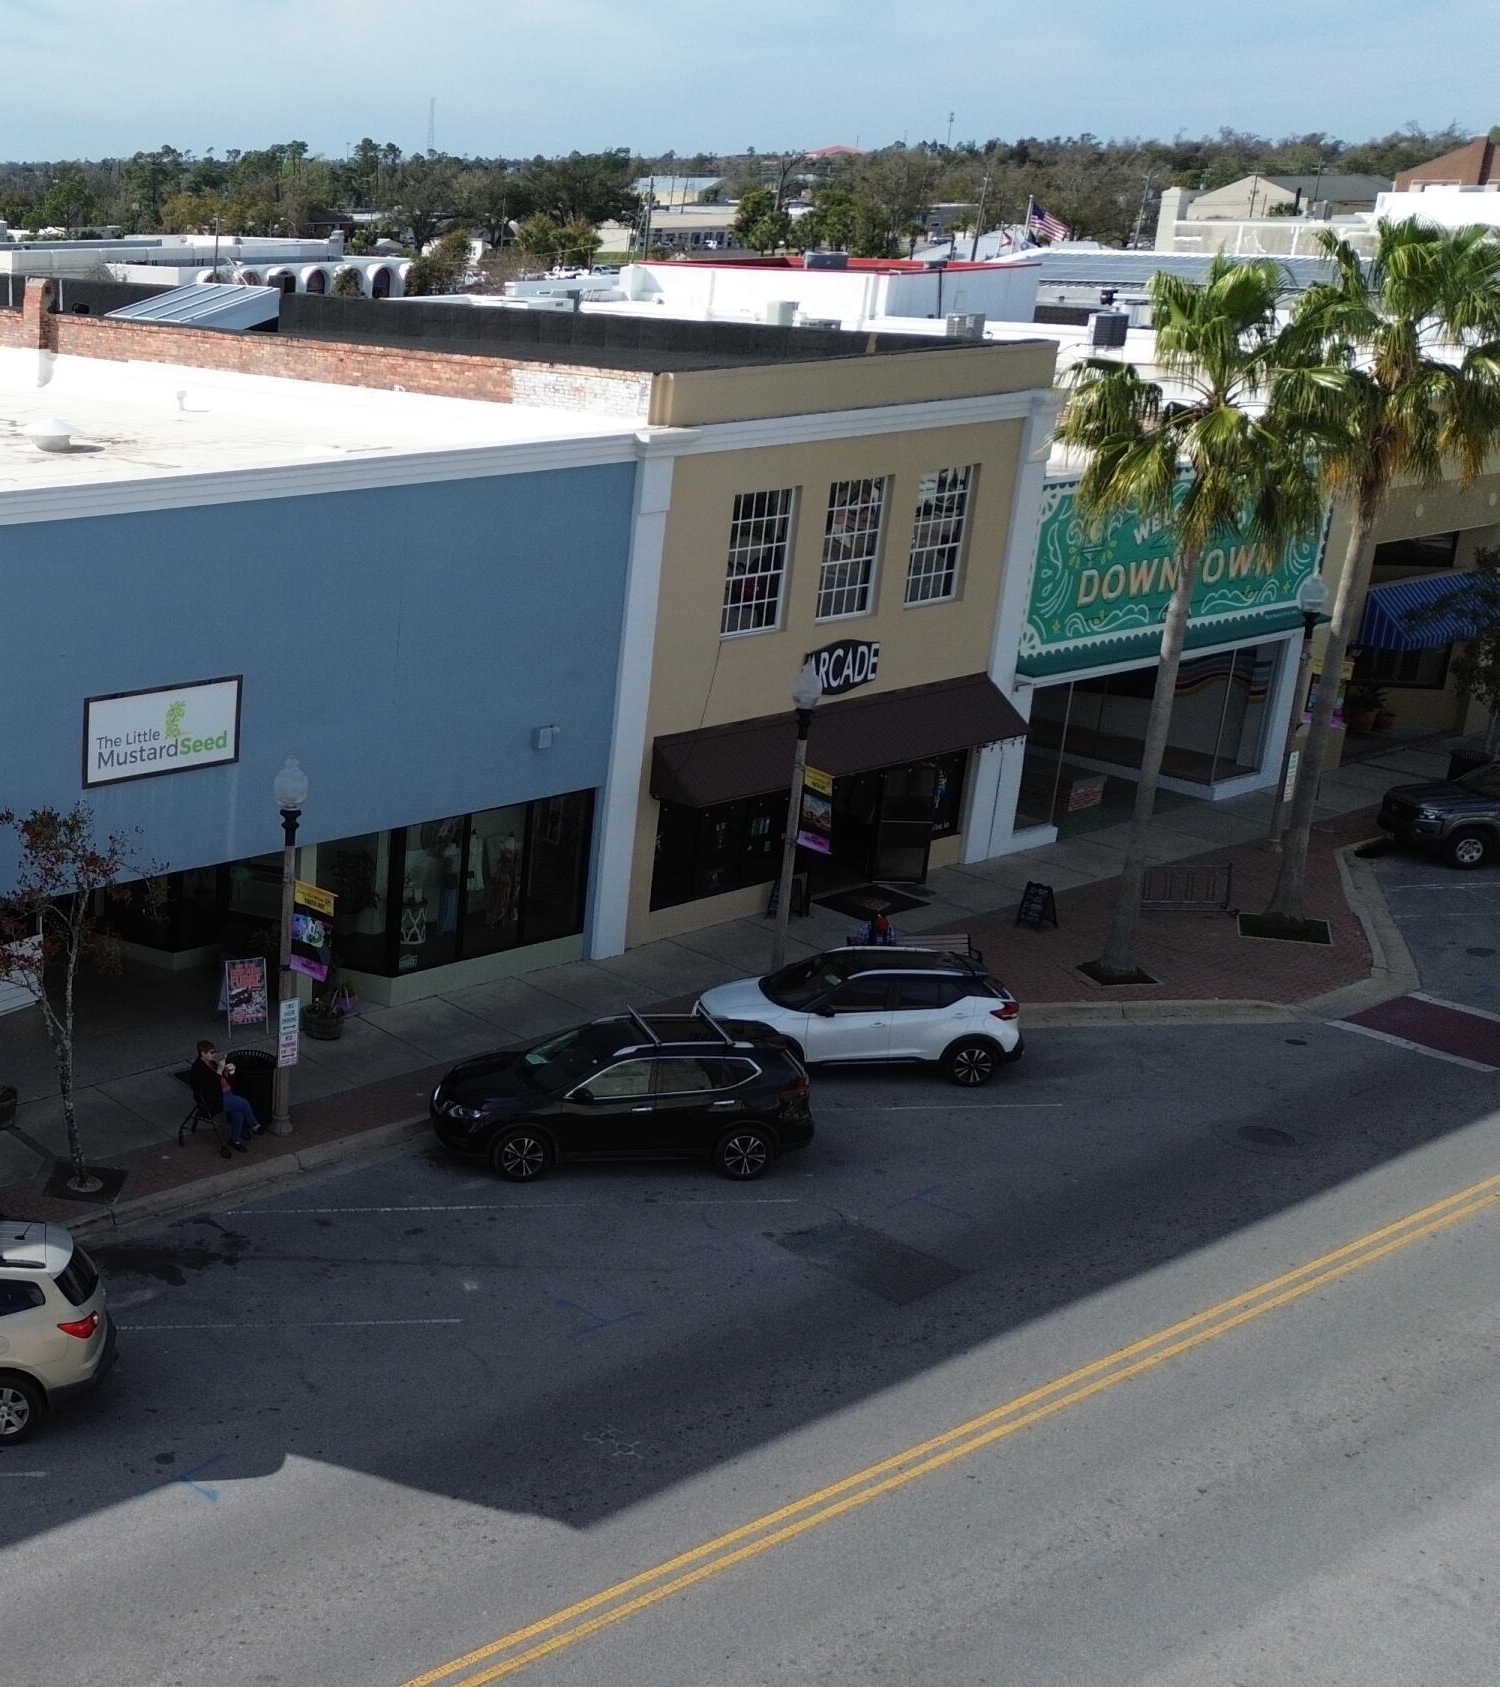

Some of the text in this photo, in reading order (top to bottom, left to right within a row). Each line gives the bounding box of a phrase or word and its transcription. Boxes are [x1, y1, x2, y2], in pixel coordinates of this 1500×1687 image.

[1077, 543, 1276, 606] DOWNOWN
[97, 729, 160, 751] The Little
